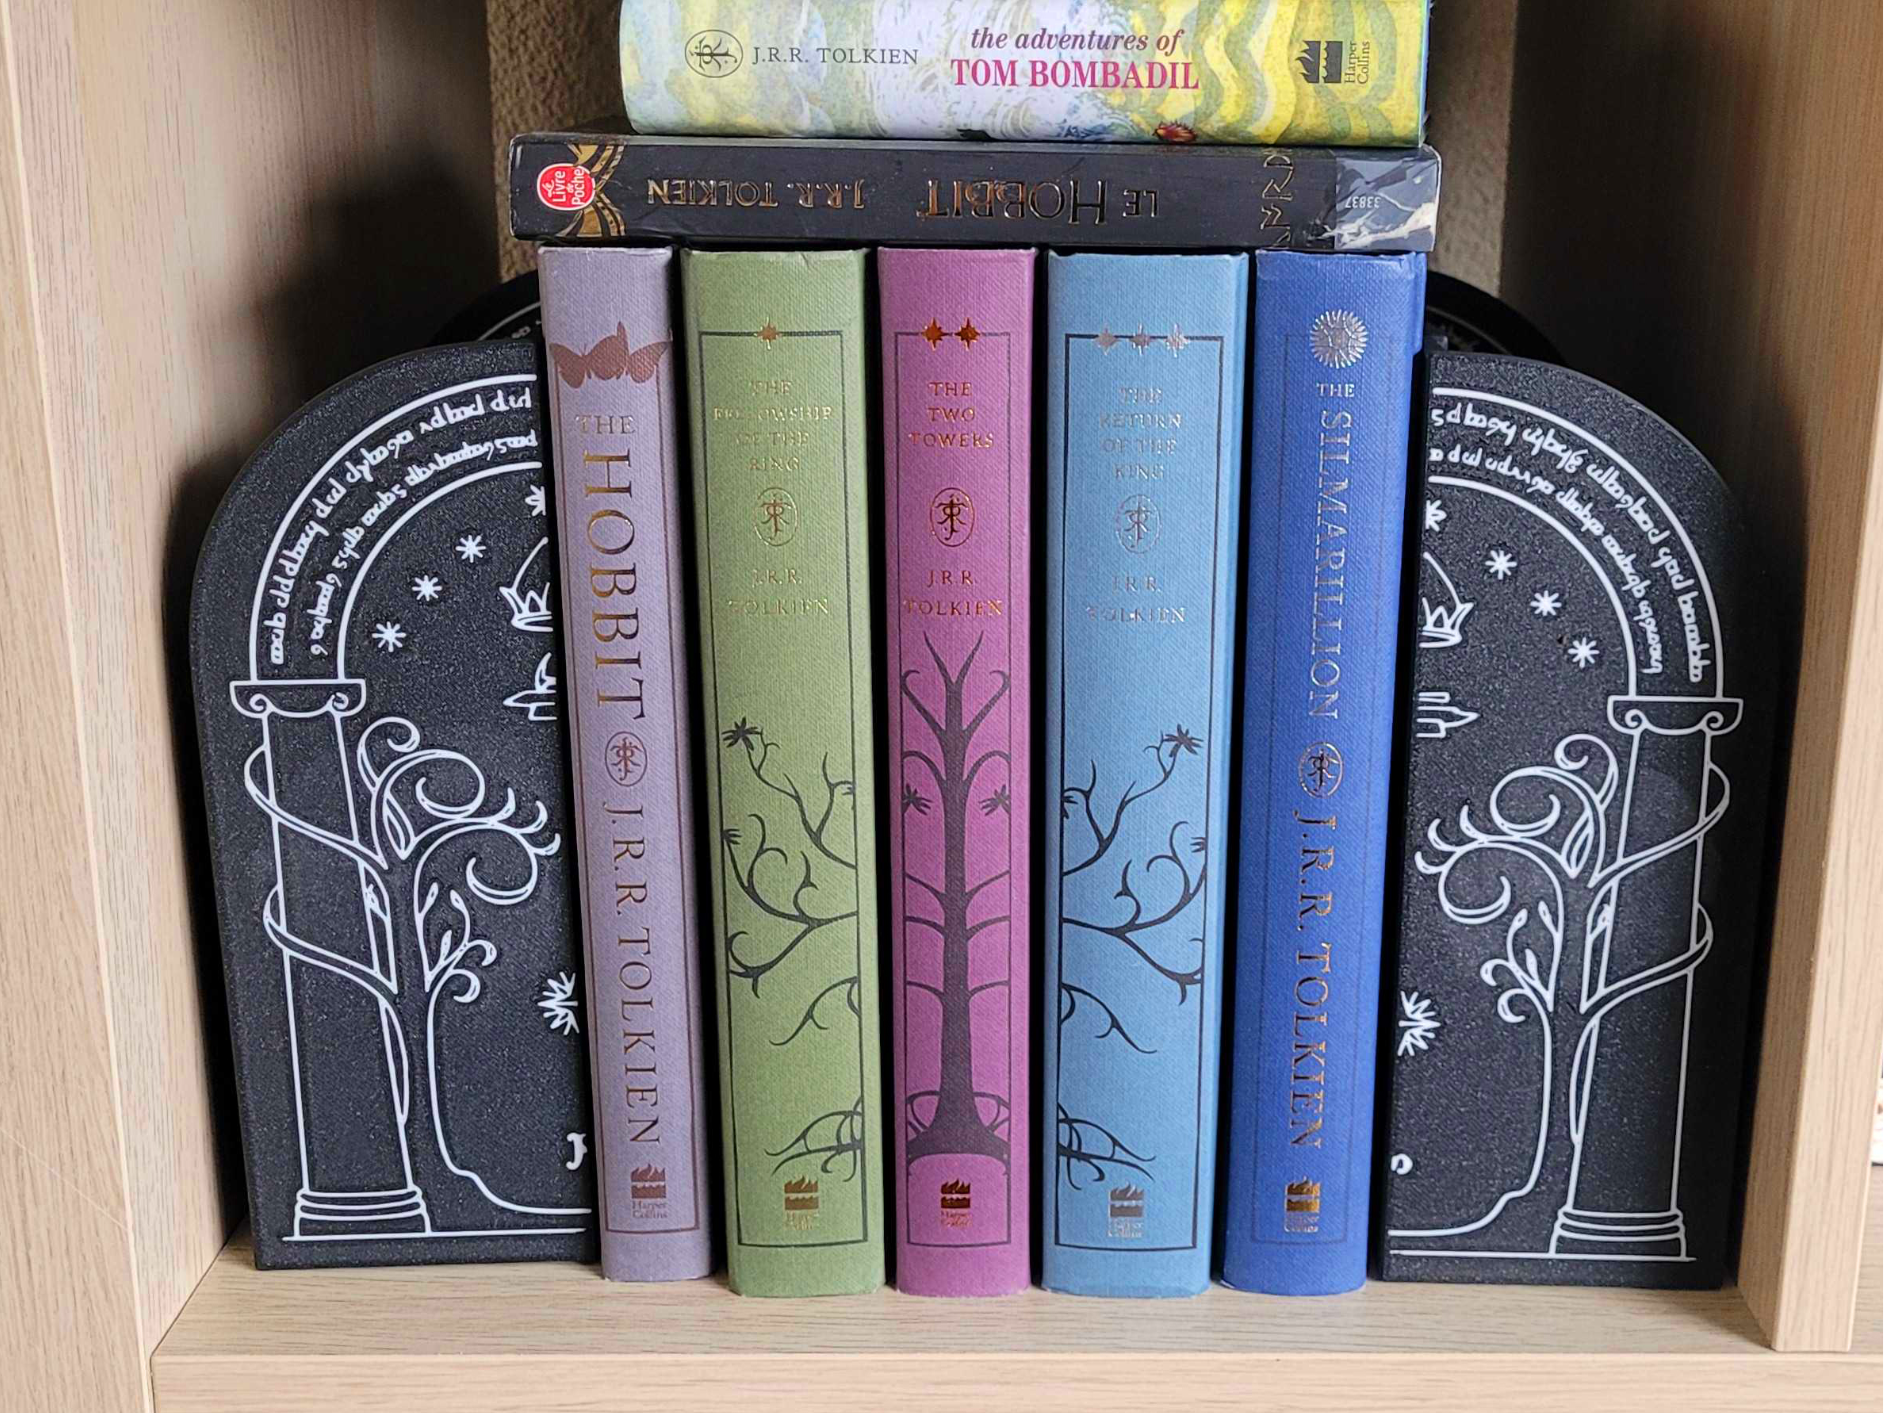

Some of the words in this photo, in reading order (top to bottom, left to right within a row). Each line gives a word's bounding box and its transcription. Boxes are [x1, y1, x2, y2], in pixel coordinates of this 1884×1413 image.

[752, 48, 809, 65] J.R.R.
[816, 48, 918, 65] TOLKIEN
[971, 27, 1008, 49] the
[1015, 28, 1148, 50] adventures
[1156, 29, 1185, 56] of
[950, 59, 1019, 87] TOM
[1028, 60, 1199, 90] BOMBADIL
[1344, 41, 1360, 84] Harper
[1357, 41, 1370, 84] Collins
[552, 170, 567, 202] Livre
[571, 168, 586, 205] Poche
[646, 178, 778, 208] TOLKIEN
[786, 178, 865, 209] J.R.R.
[916, 178, 1107, 225] HOBBIT
[1123, 189, 1160, 217] LE
[1344, 194, 1382, 210] 33837
[929, 381, 972, 397] THE
[1316, 383, 1355, 398] THE
[575, 415, 636, 435] THE
[927, 407, 976, 423] TWO
[908, 432, 994, 448] TOWERS
[1309, 410, 1352, 719] SILMARILLION
[582, 449, 646, 720] HOBBIT
[903, 599, 1002, 617] TOLKIEN
[602, 801, 646, 916] J.R.R.
[1294, 809, 1337, 931] J.R.R.
[617, 927, 661, 1146] TOLKIEN
[1289, 942, 1332, 1150] TOLKIEN
